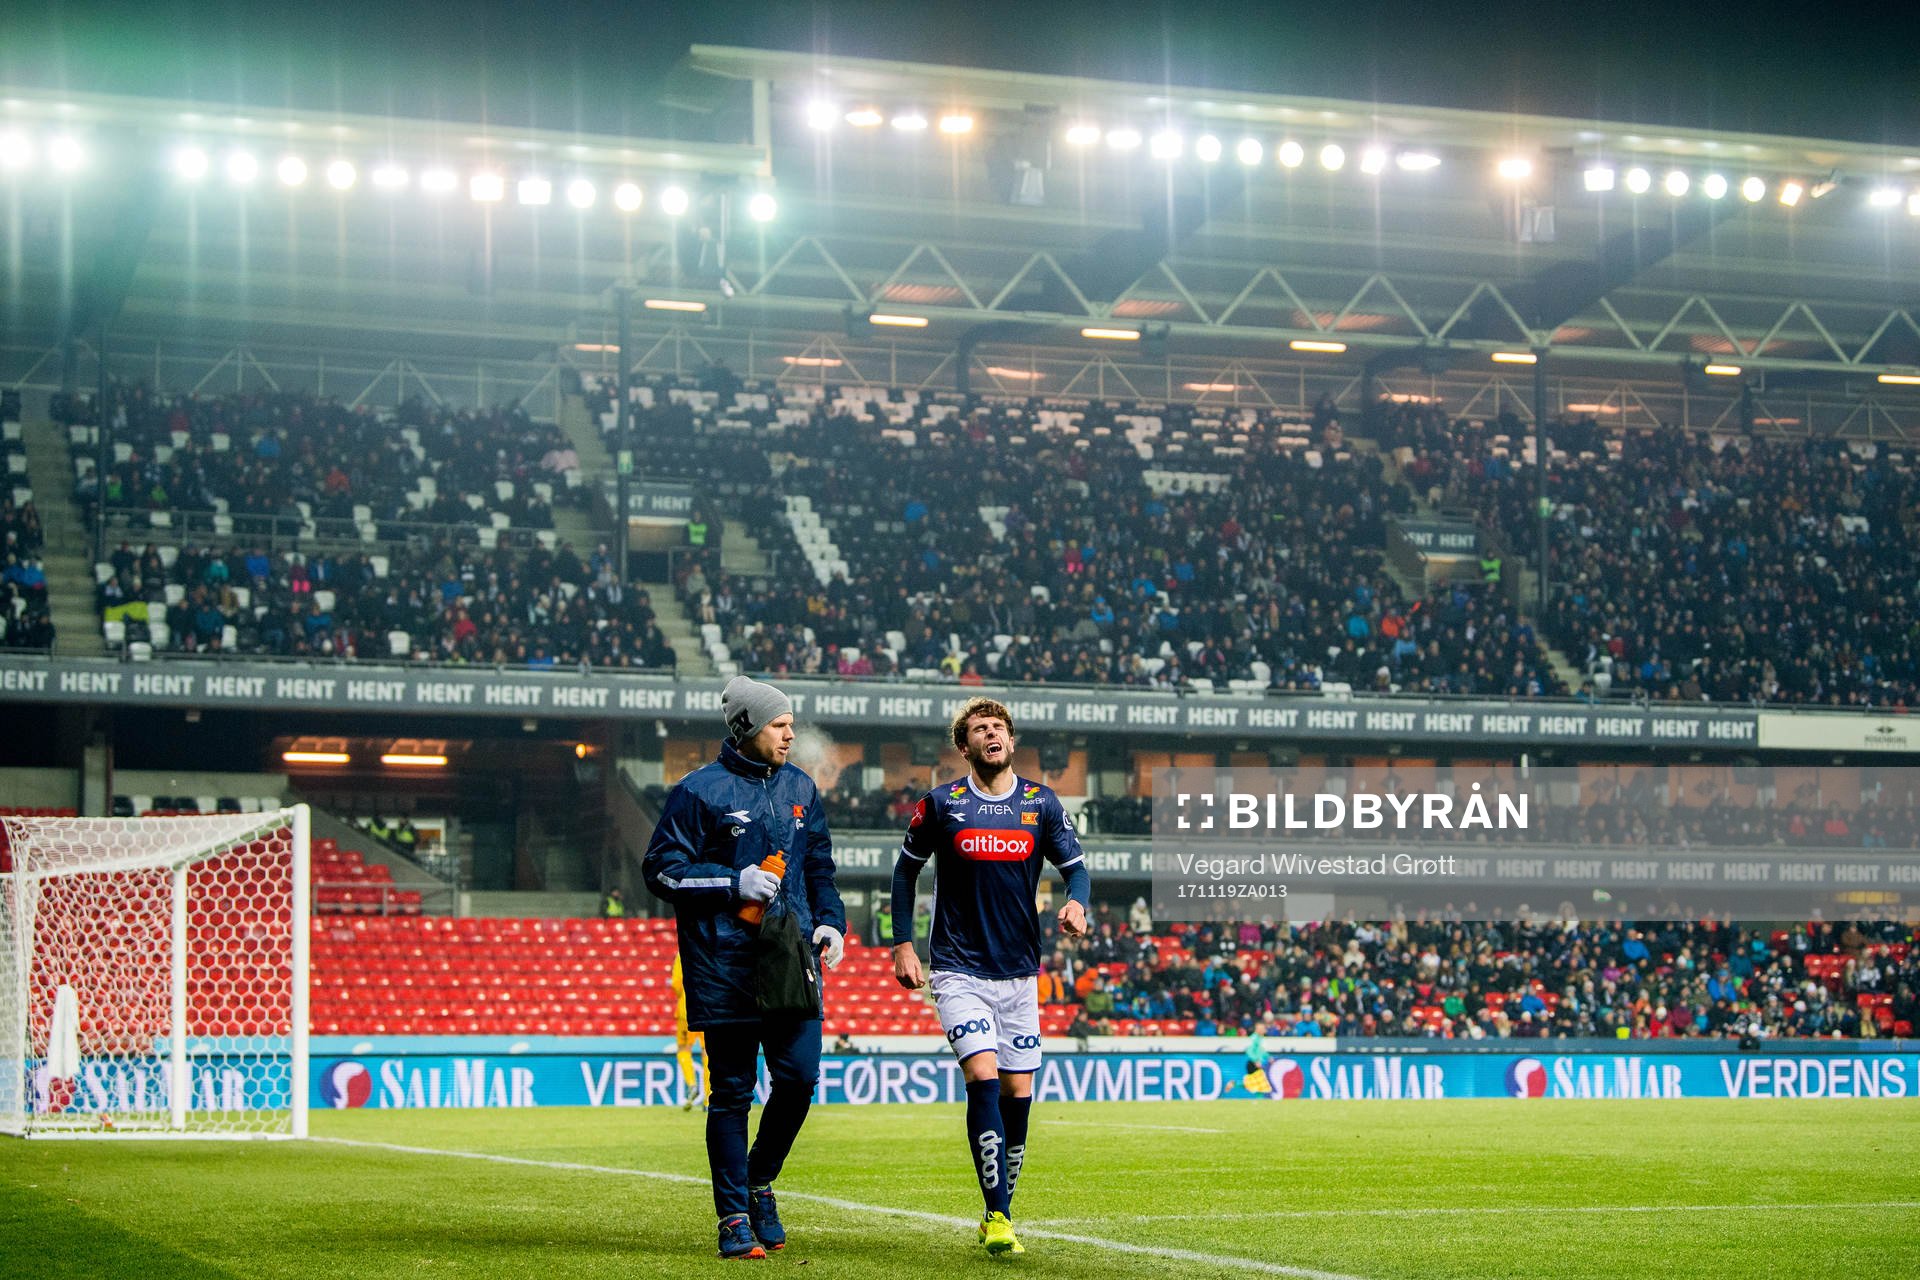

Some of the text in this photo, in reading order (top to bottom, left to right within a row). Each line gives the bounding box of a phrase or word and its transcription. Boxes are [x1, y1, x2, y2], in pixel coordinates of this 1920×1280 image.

[0, 670, 47, 690] ENT
[60, 671, 121, 692] HENT
[133, 674, 194, 694] HENT
[206, 676, 265, 696] HENT
[276, 678, 336, 698] HENT
[347, 680, 406, 700] HENT
[416, 682, 474, 702] HENT
[485, 685, 542, 705] HENT
[552, 687, 609, 707] HENT
[619, 689, 675, 709] HENT
[815, 695, 870, 714] HENT
[879, 697, 933, 717] HENT
[1066, 703, 1119, 722] HENT
[1127, 705, 1179, 724] HENT
[1188, 707, 1239, 725] HENT
[1248, 709, 1298, 727] HENT
[1307, 711, 1358, 729] HENT
[1366, 712, 1416, 730] HENT
[1424, 713, 1474, 731] HENT
[1482, 715, 1531, 733] HENT
[1539, 717, 1588, 734] HENT
[1596, 718, 1644, 735] HENT
[1652, 719, 1700, 737] HENT
[1708, 720, 1755, 738] HENT
[977, 804, 1014, 815] ATEA
[961, 835, 1029, 854] altibox
[1497, 860, 1546, 878] HENT
[1554, 860, 1603, 879] HENT
[1611, 861, 1660, 880] HENT
[1667, 862, 1715, 881] HENT
[1723, 863, 1771, 881] HENT
[1779, 864, 1826, 882] HENT
[1834, 864, 1881, 883] HENT
[947, 1018, 990, 1043] coop
[817, 1057, 962, 1105] FØRST
[1036, 1058, 1223, 1102] AVMERD
[1720, 1058, 1908, 1098] VERDENS
[978, 1129, 1003, 1190] coop
